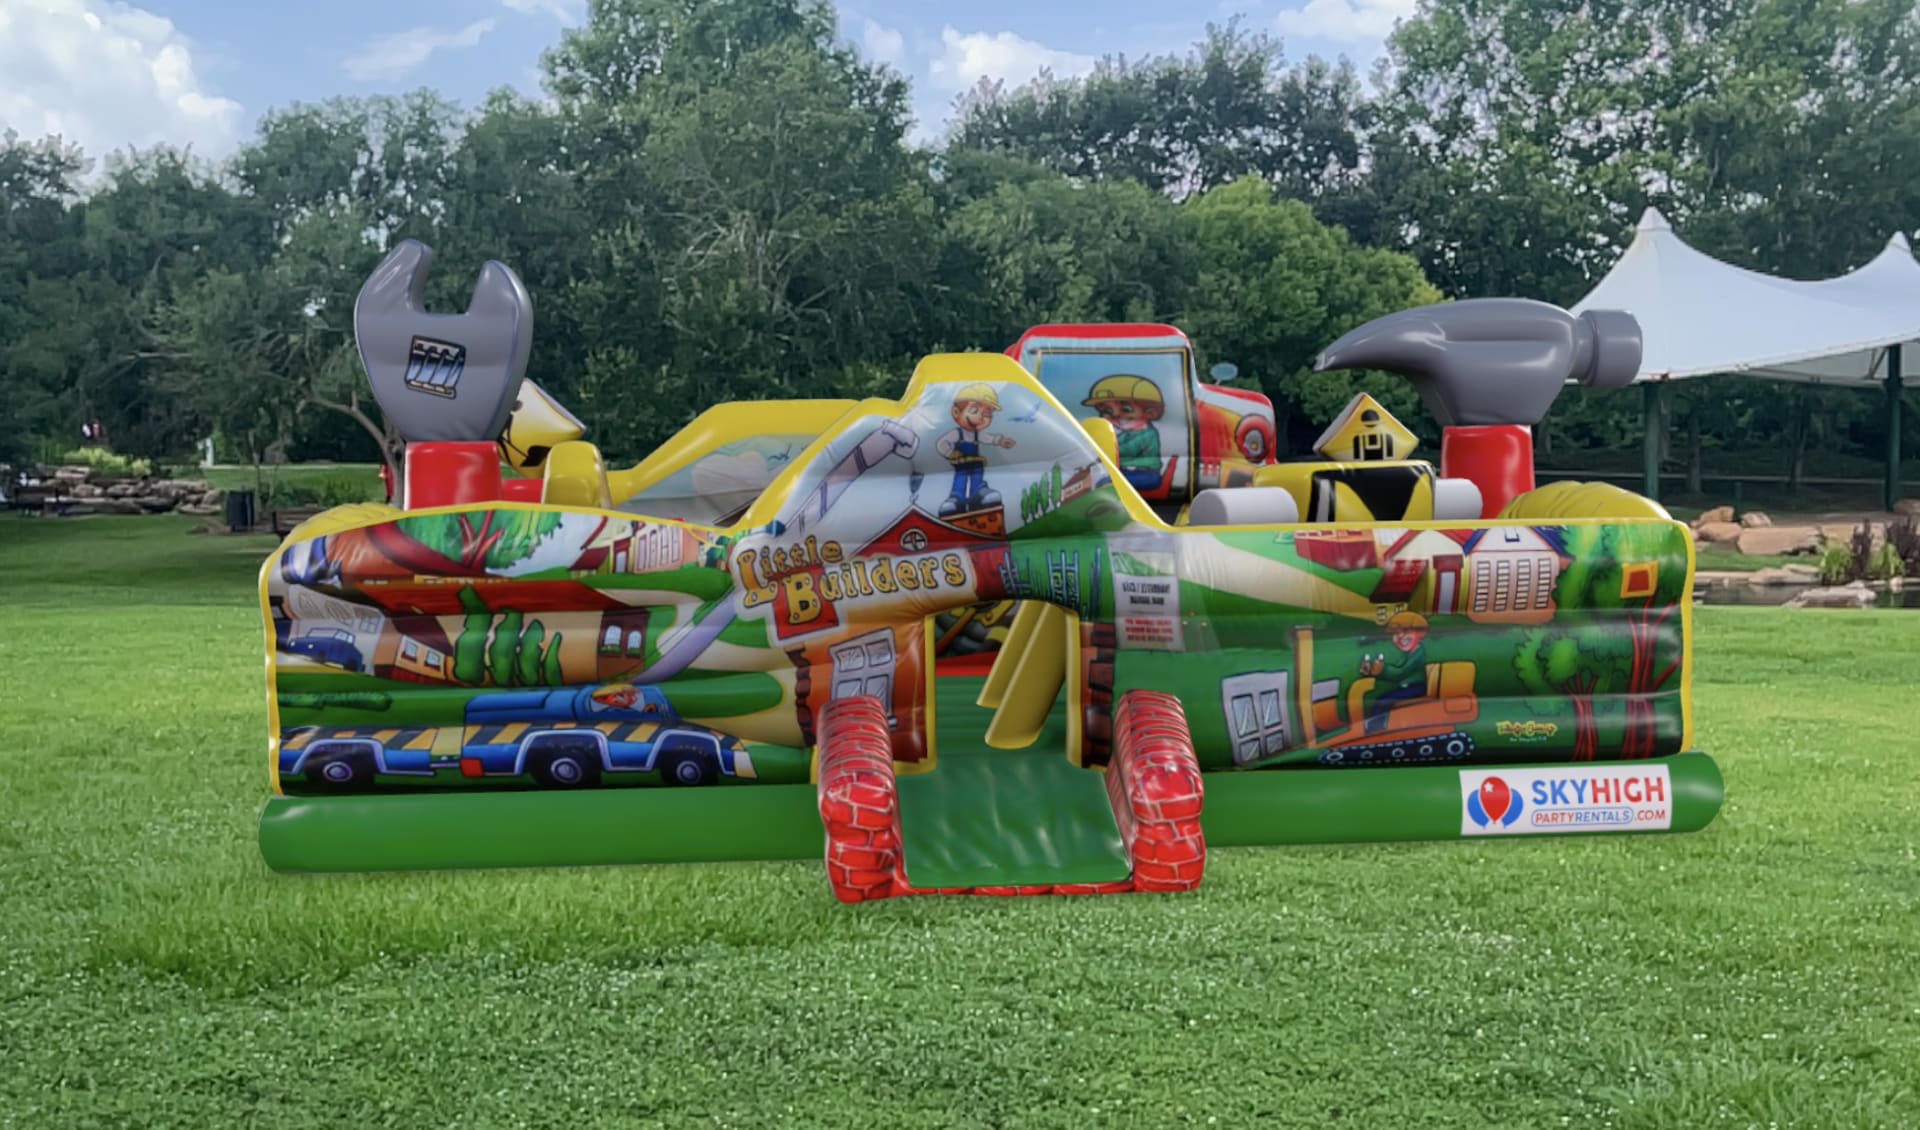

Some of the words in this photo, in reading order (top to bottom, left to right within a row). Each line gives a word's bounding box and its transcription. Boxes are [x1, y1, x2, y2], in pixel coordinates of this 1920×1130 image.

[737, 535, 843, 608] Little
[782, 553, 967, 625] Builders
[1531, 776, 1665, 805] SKYHIGH
